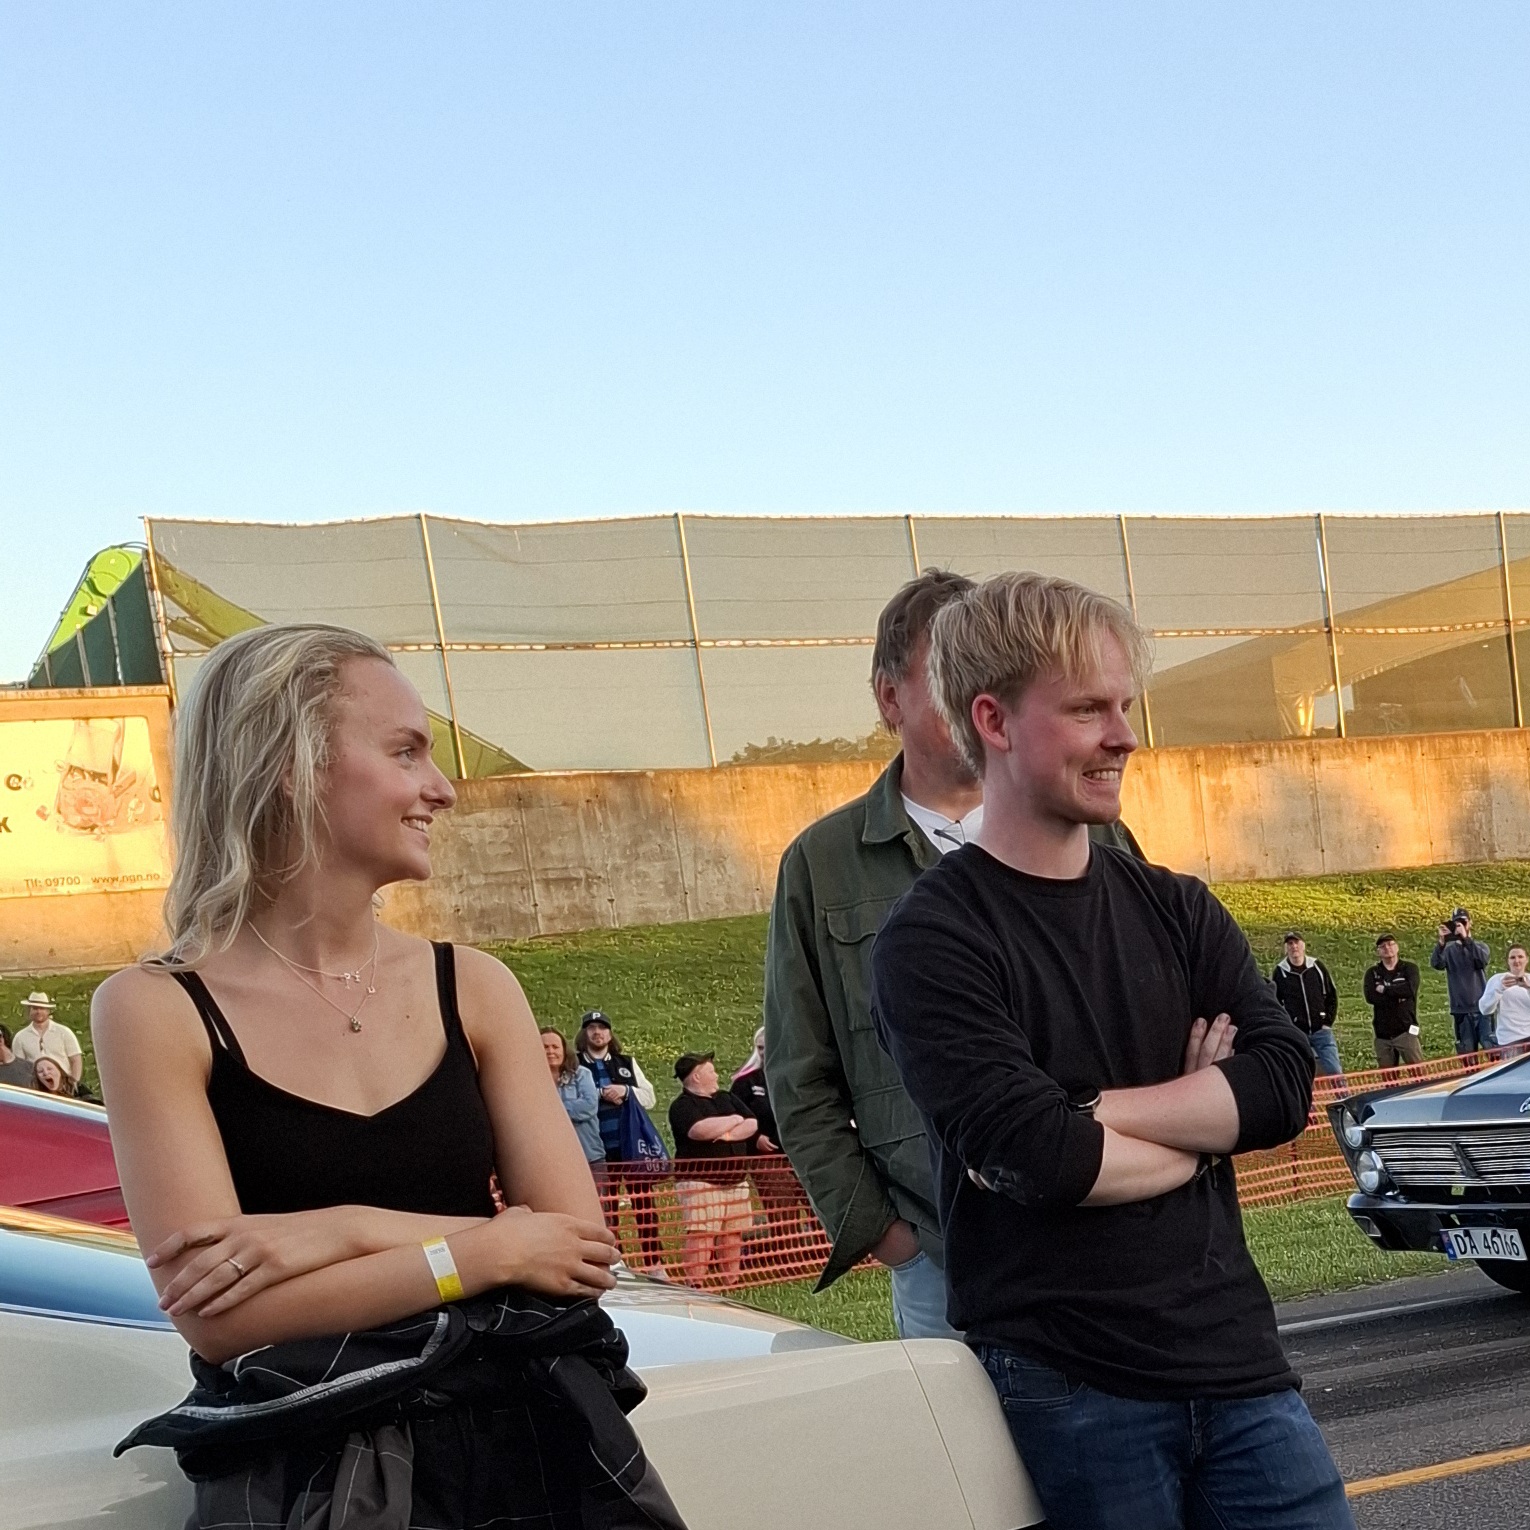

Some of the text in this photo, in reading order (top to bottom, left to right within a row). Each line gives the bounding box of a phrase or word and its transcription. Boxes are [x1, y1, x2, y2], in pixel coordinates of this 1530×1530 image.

[24, 872, 161, 888] Tlf: 09700 www.ngn.no
[592, 1012, 601, 1020] P
[1453, 1232, 1521, 1257] DA 46166
